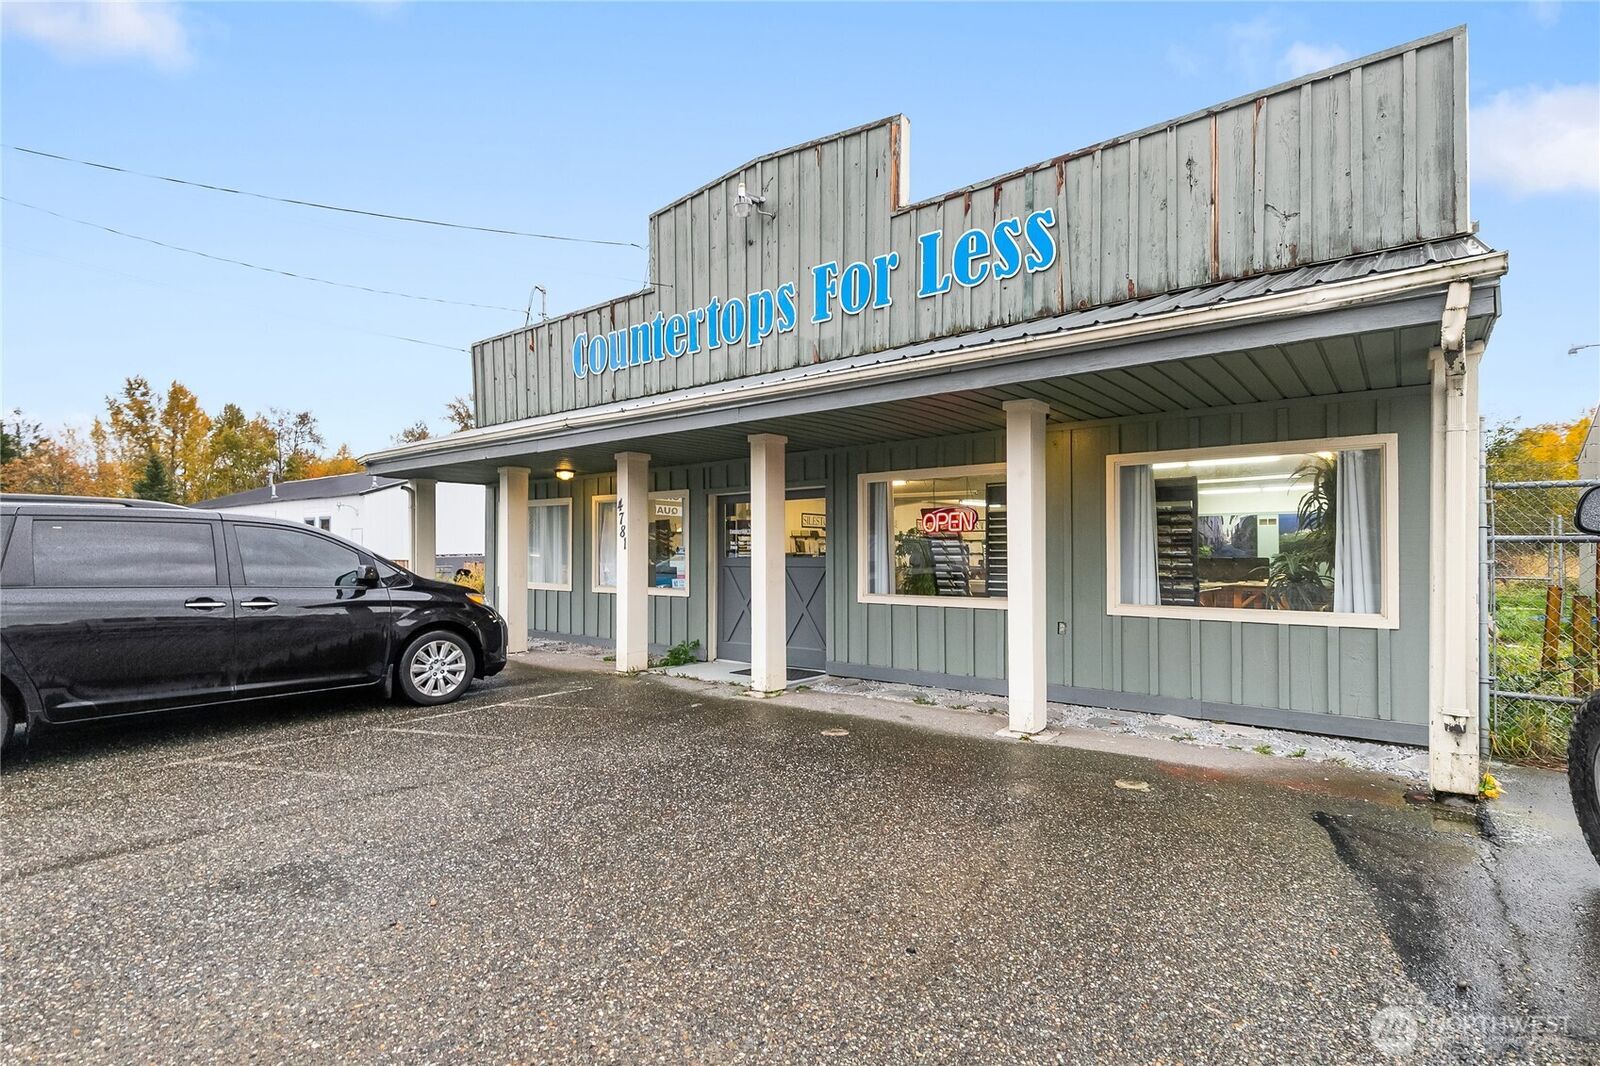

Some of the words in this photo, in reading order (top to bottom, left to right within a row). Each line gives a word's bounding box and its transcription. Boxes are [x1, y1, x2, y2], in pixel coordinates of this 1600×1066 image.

[572, 282, 797, 378] Countertops
[811, 251, 899, 324] For
[917, 207, 1056, 298] Less
[618, 498, 627, 550] 4781
[922, 511, 974, 532] OPEN
